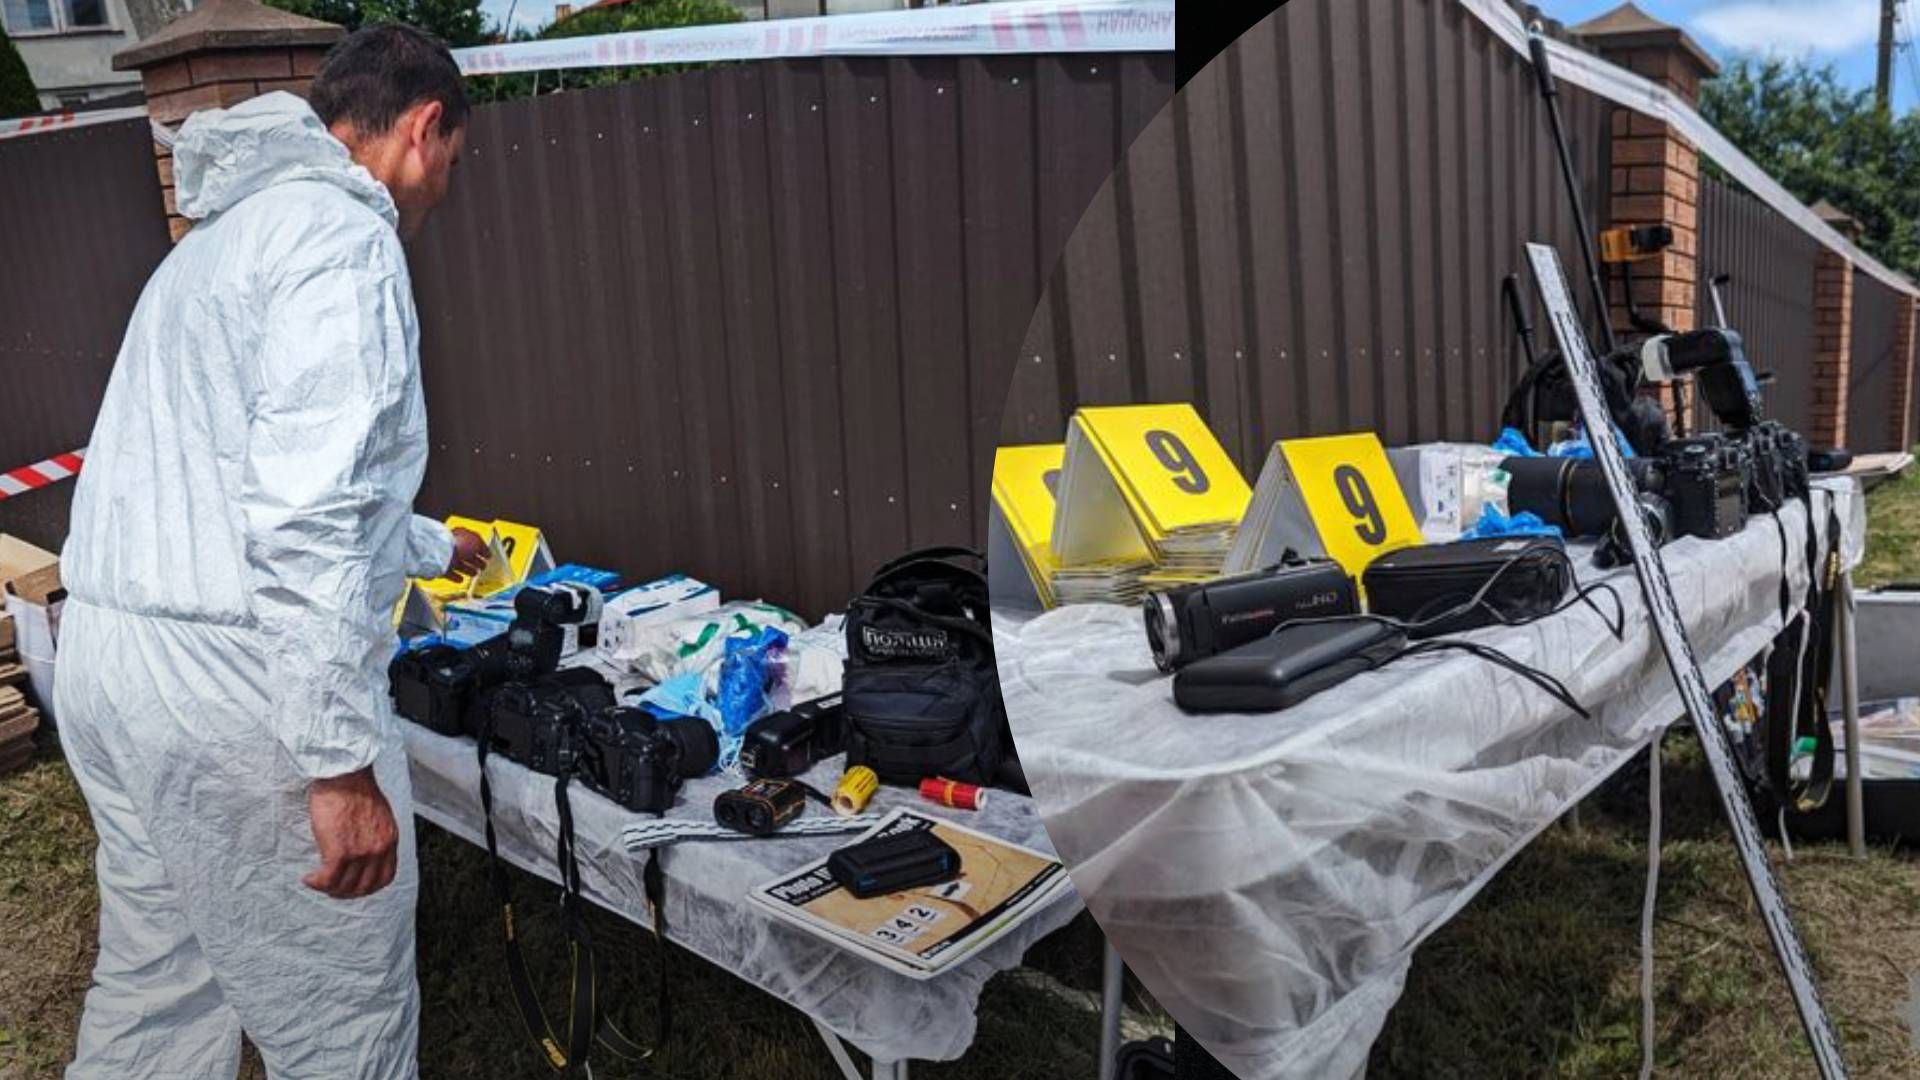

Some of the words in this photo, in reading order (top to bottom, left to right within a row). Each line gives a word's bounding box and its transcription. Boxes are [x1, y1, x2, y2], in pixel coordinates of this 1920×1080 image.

[1144, 430, 1211, 495] 9
[1333, 463, 1387, 545] 9
[896, 918, 913, 929] 4
[909, 906, 931, 918] 2
